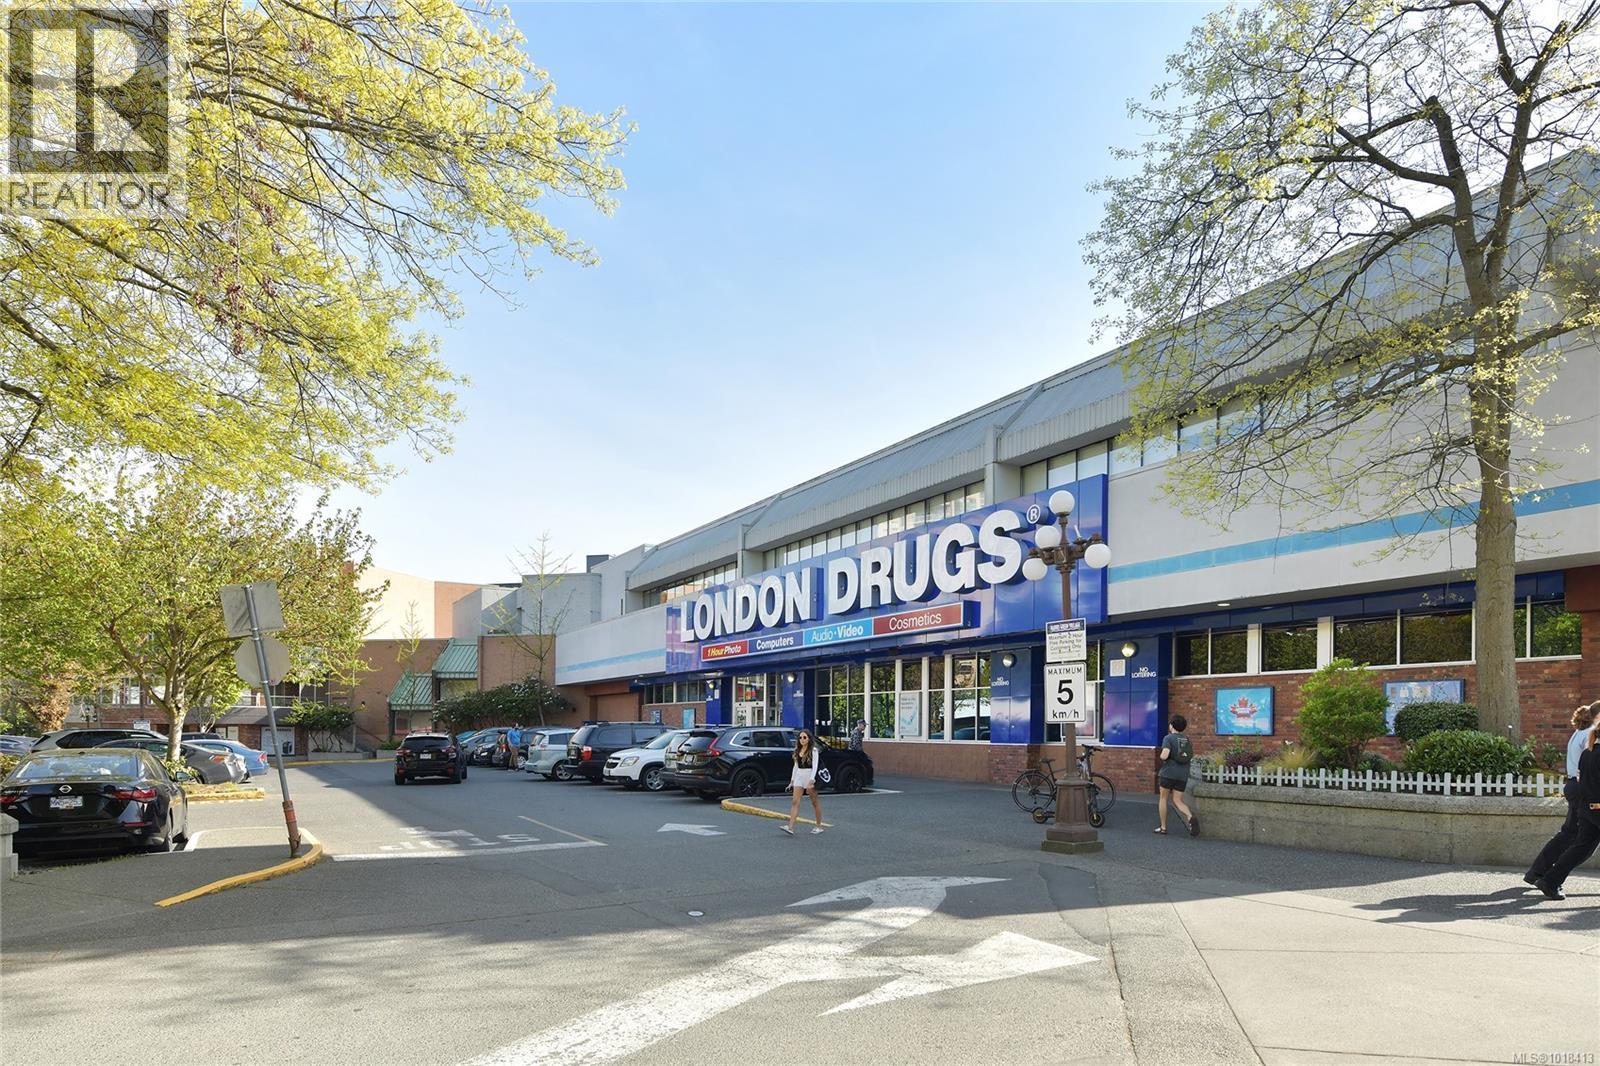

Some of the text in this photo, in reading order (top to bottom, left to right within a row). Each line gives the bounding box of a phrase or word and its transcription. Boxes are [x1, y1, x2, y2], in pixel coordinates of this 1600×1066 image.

[680, 567, 811, 642] LONDON
[889, 610, 942, 631] Cosmetics
[756, 636, 794, 651] Computers
[1047, 667, 1082, 675] MAXIMUM
[1056, 679, 1074, 705] 5
[1052, 709, 1079, 719] km/h
